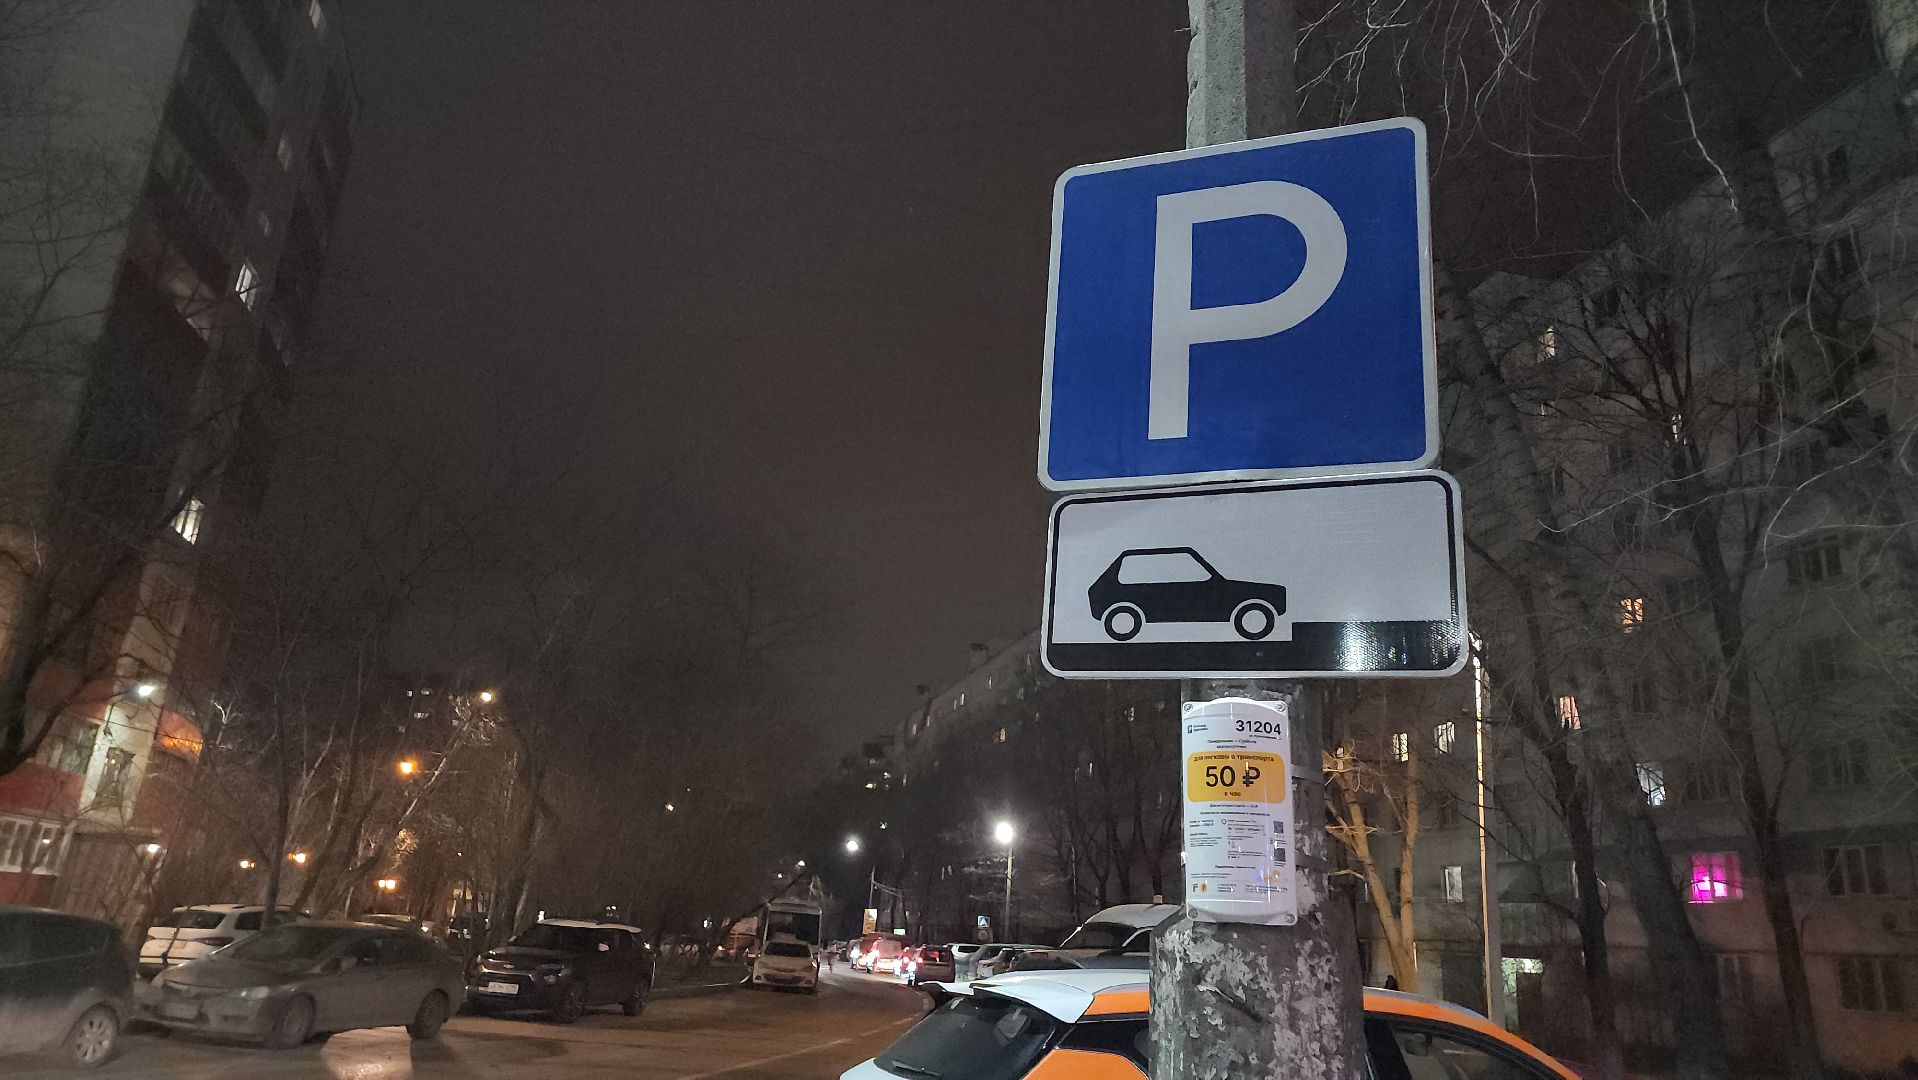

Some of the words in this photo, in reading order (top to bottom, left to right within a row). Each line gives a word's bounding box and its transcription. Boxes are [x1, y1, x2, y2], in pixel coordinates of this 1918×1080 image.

[1147, 180, 1348, 441] P
[1235, 719, 1281, 735] 31204
[1205, 765, 1236, 788] 50
